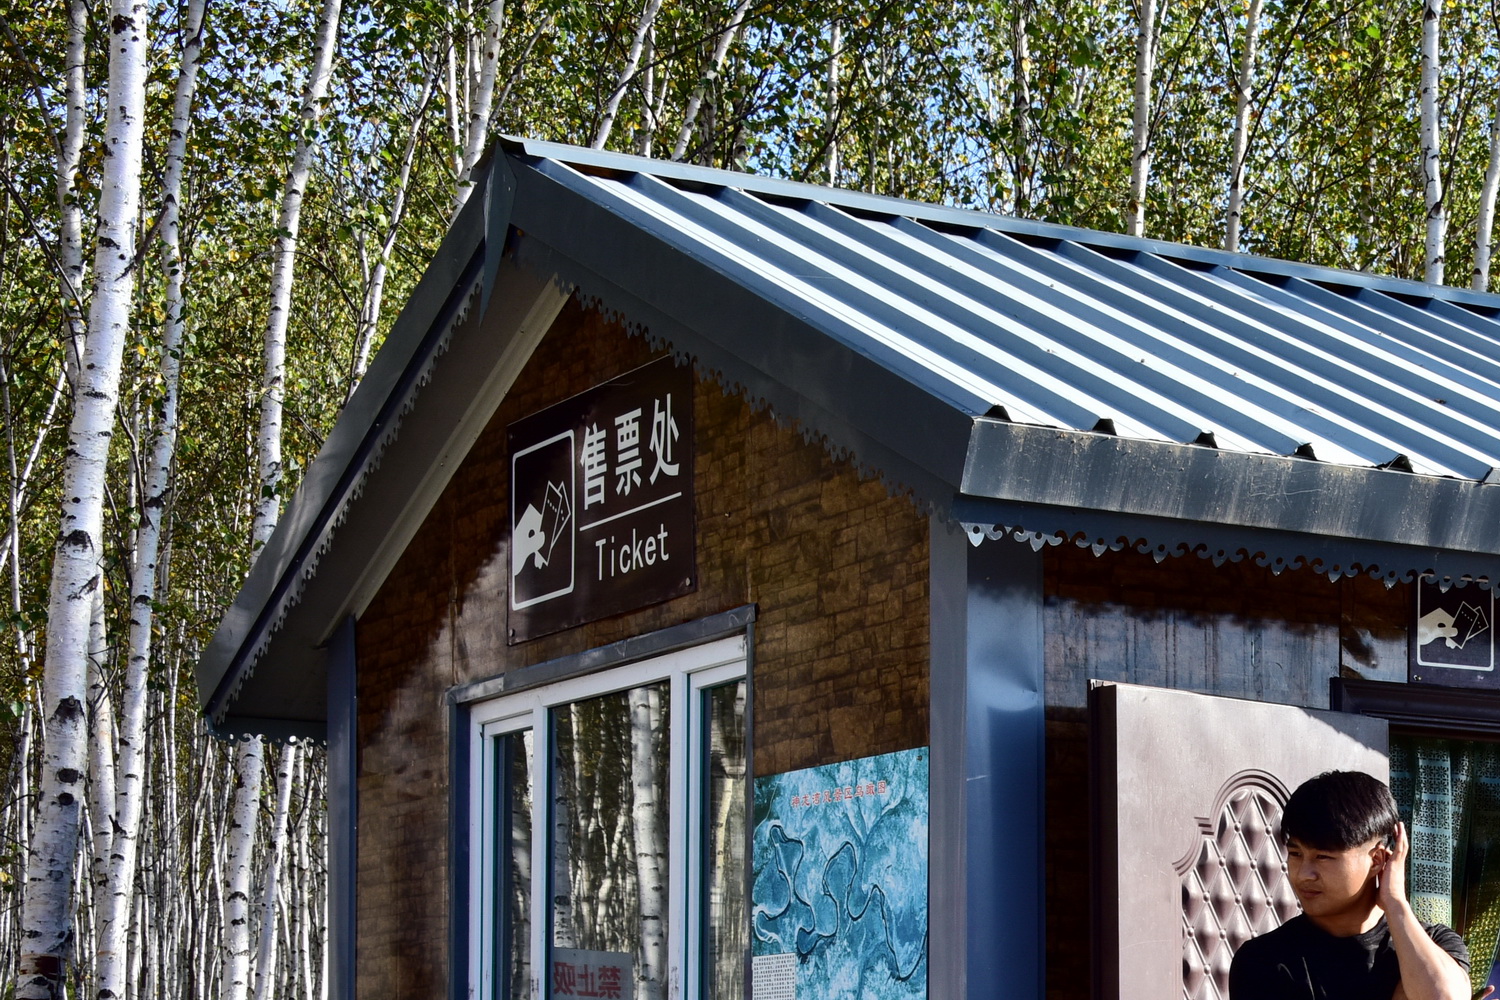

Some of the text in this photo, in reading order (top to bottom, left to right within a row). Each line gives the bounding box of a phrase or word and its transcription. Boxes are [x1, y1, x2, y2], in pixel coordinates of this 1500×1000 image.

[580, 392, 680, 511] 售票处
[595, 523, 669, 581] Ticket
[791, 781, 886, 808] 神龙湾风景区鸟瞰图
